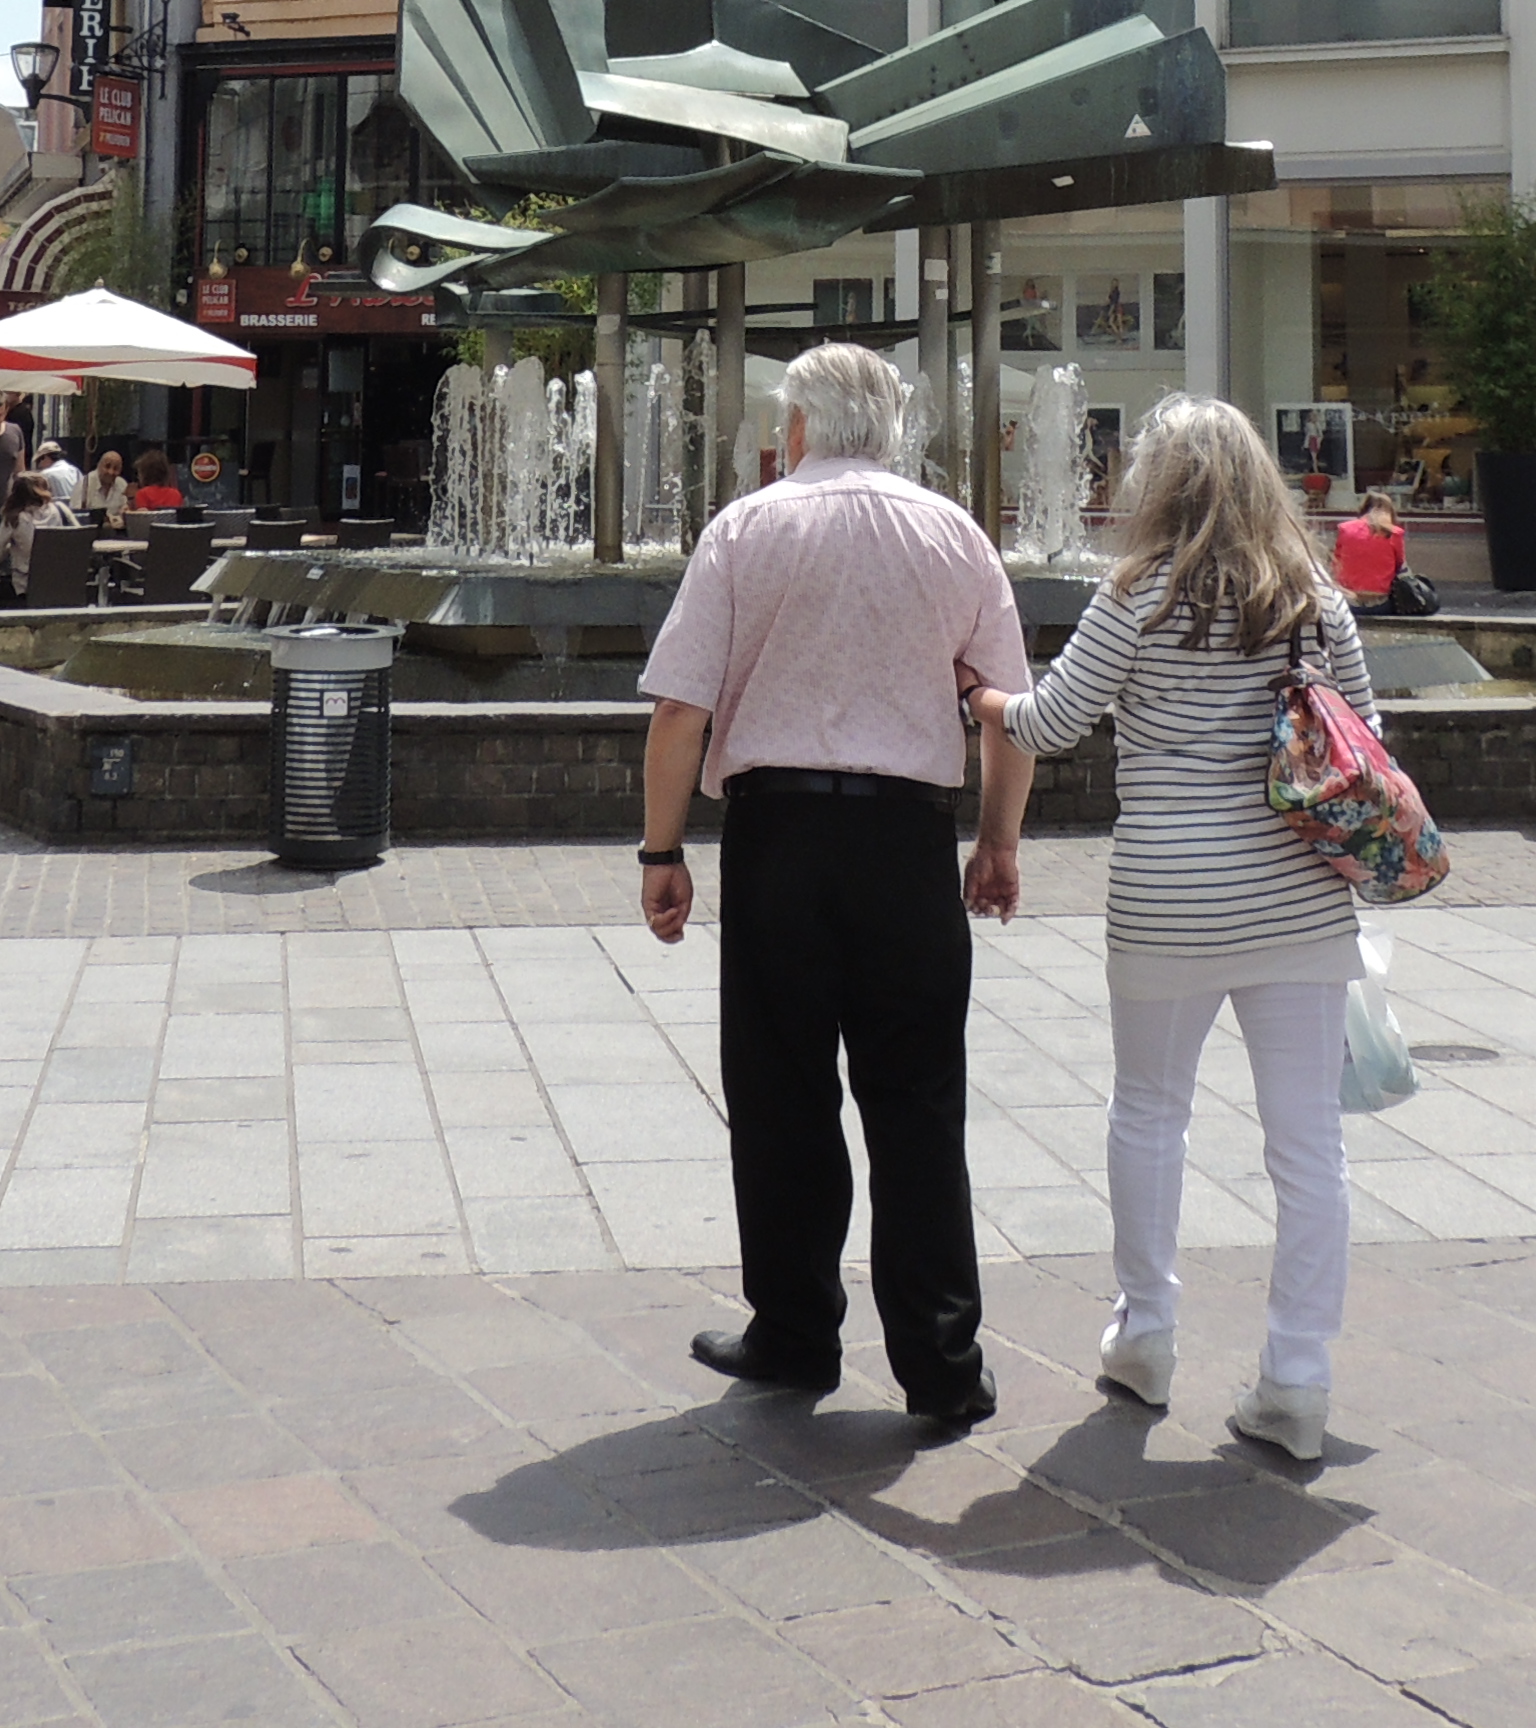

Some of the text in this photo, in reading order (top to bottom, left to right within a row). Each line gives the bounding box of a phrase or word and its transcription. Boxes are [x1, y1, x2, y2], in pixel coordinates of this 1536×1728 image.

[99, 87, 132, 108] LE CLUB
[99, 106, 132, 126] PELICAN
[202, 284, 229, 294] LE CLUB
[201, 295, 229, 305] PELICAN
[240, 313, 318, 327] BRASSERIE
